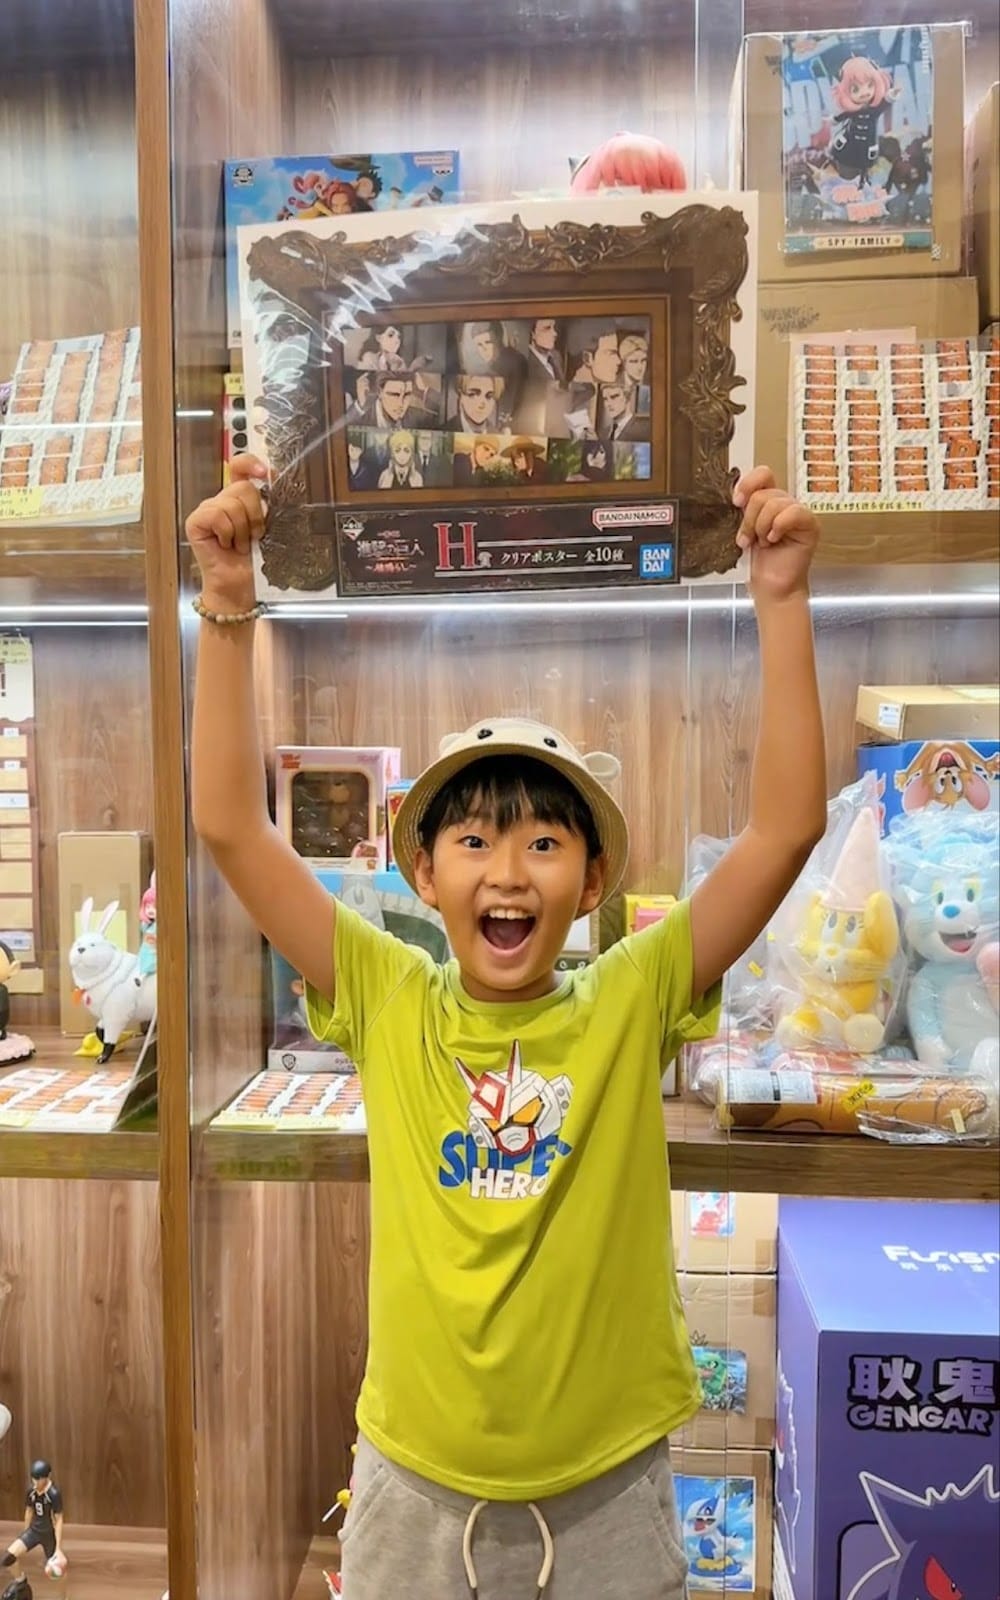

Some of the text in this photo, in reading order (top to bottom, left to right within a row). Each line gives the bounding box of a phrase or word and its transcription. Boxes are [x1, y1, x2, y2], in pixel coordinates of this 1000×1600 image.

[854, 236, 892, 246] FAMILY
[599, 510, 668, 522] BANDAI NAMCO
[501, 550, 578, 565] クリアポスター
[584, 547, 625, 563] 全10種
[642, 548, 670, 561] BAN
[642, 560, 665, 573] DAI
[470, 1167, 548, 1199] HERO
[851, 1356, 997, 1404] 耿鬼
[848, 1403, 991, 1433] GENGAR
[35, 1502, 44, 1516] 9
